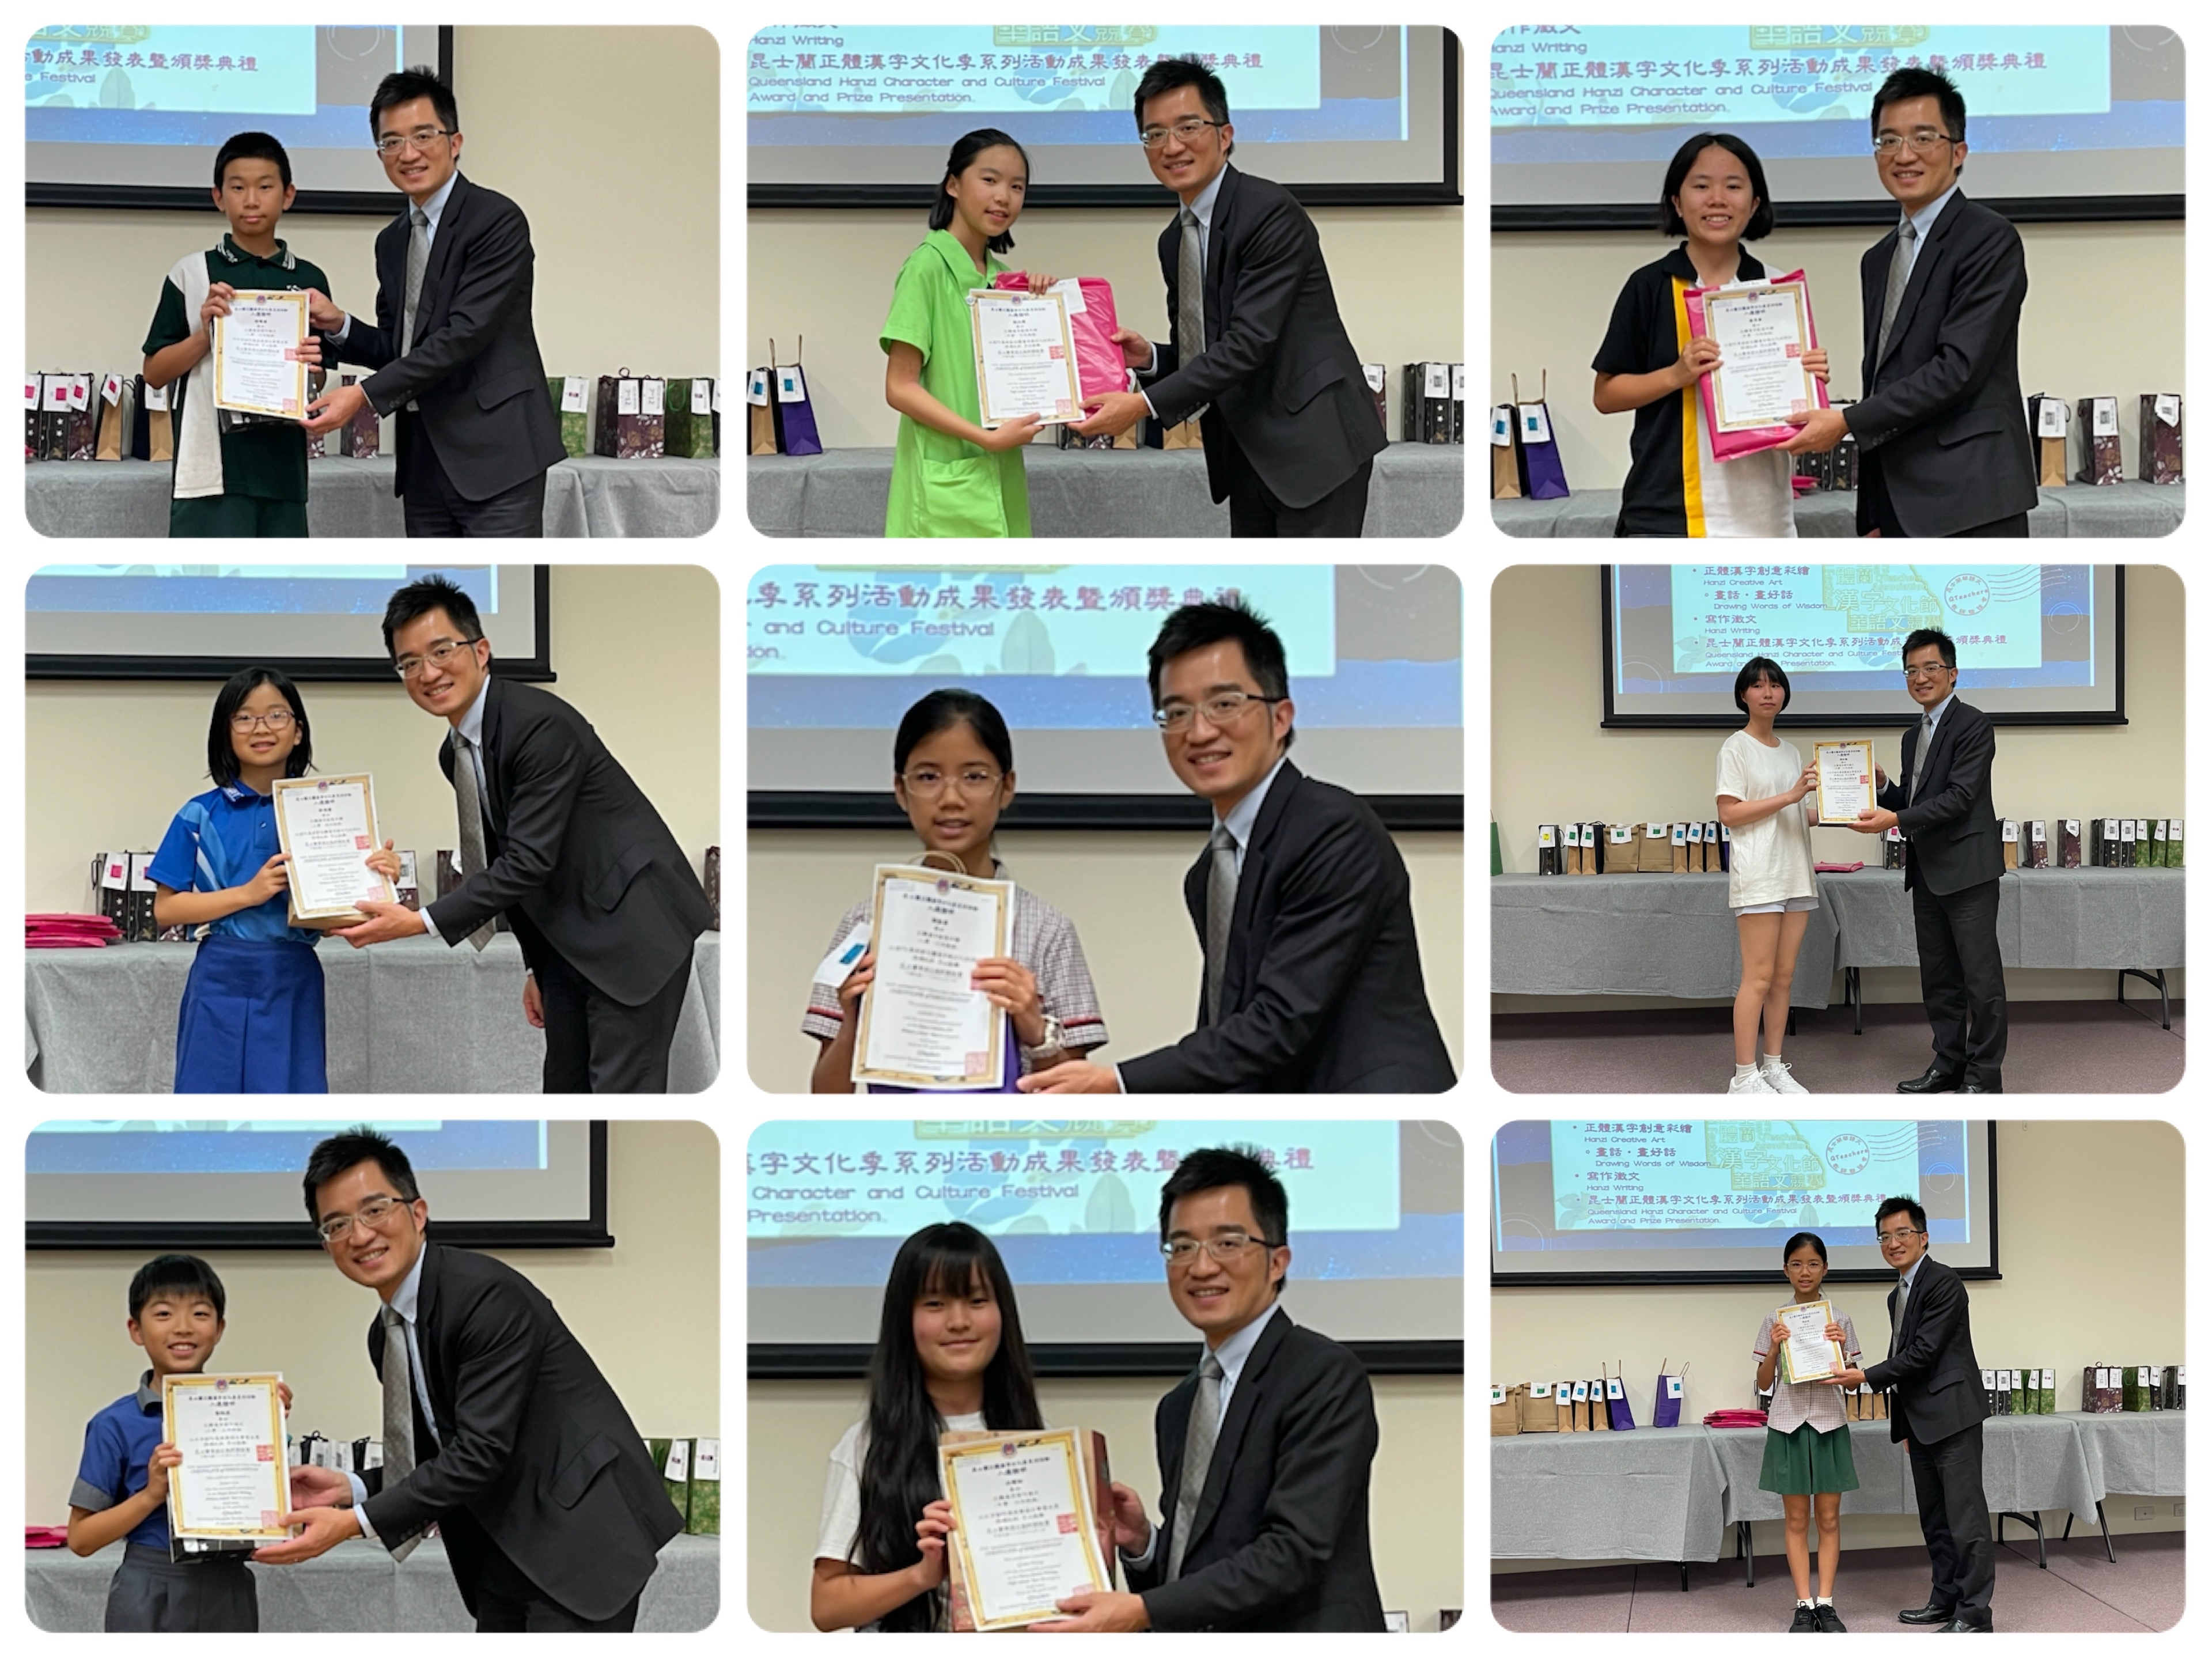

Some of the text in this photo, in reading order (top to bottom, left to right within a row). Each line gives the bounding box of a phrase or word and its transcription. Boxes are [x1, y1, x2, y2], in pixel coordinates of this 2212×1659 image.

[792, 36, 843, 47] Writing
[1532, 42, 1587, 54] Writing
[25, 48, 258, 71] 動成果發表暨頒獎典禮
[40, 71, 96, 83] Festival
[749, 77, 1104, 87] Queensland Hanzi Character and Culture Festival
[1583, 88, 1623, 97] Hanzi
[1631, 86, 1707, 96] Character
[1715, 84, 1743, 95] and
[1751, 84, 1806, 94] Culture
[1816, 81, 1872, 93] Festival
[749, 92, 796, 102] Award
[804, 92, 829, 102] and
[837, 92, 873, 102] Prize
[1544, 105, 1571, 114] and
[1581, 104, 1619, 114] Prize
[764, 620, 995, 635] and Culture Festival
[752, 1184, 1079, 1200] Character and Culture Festival
